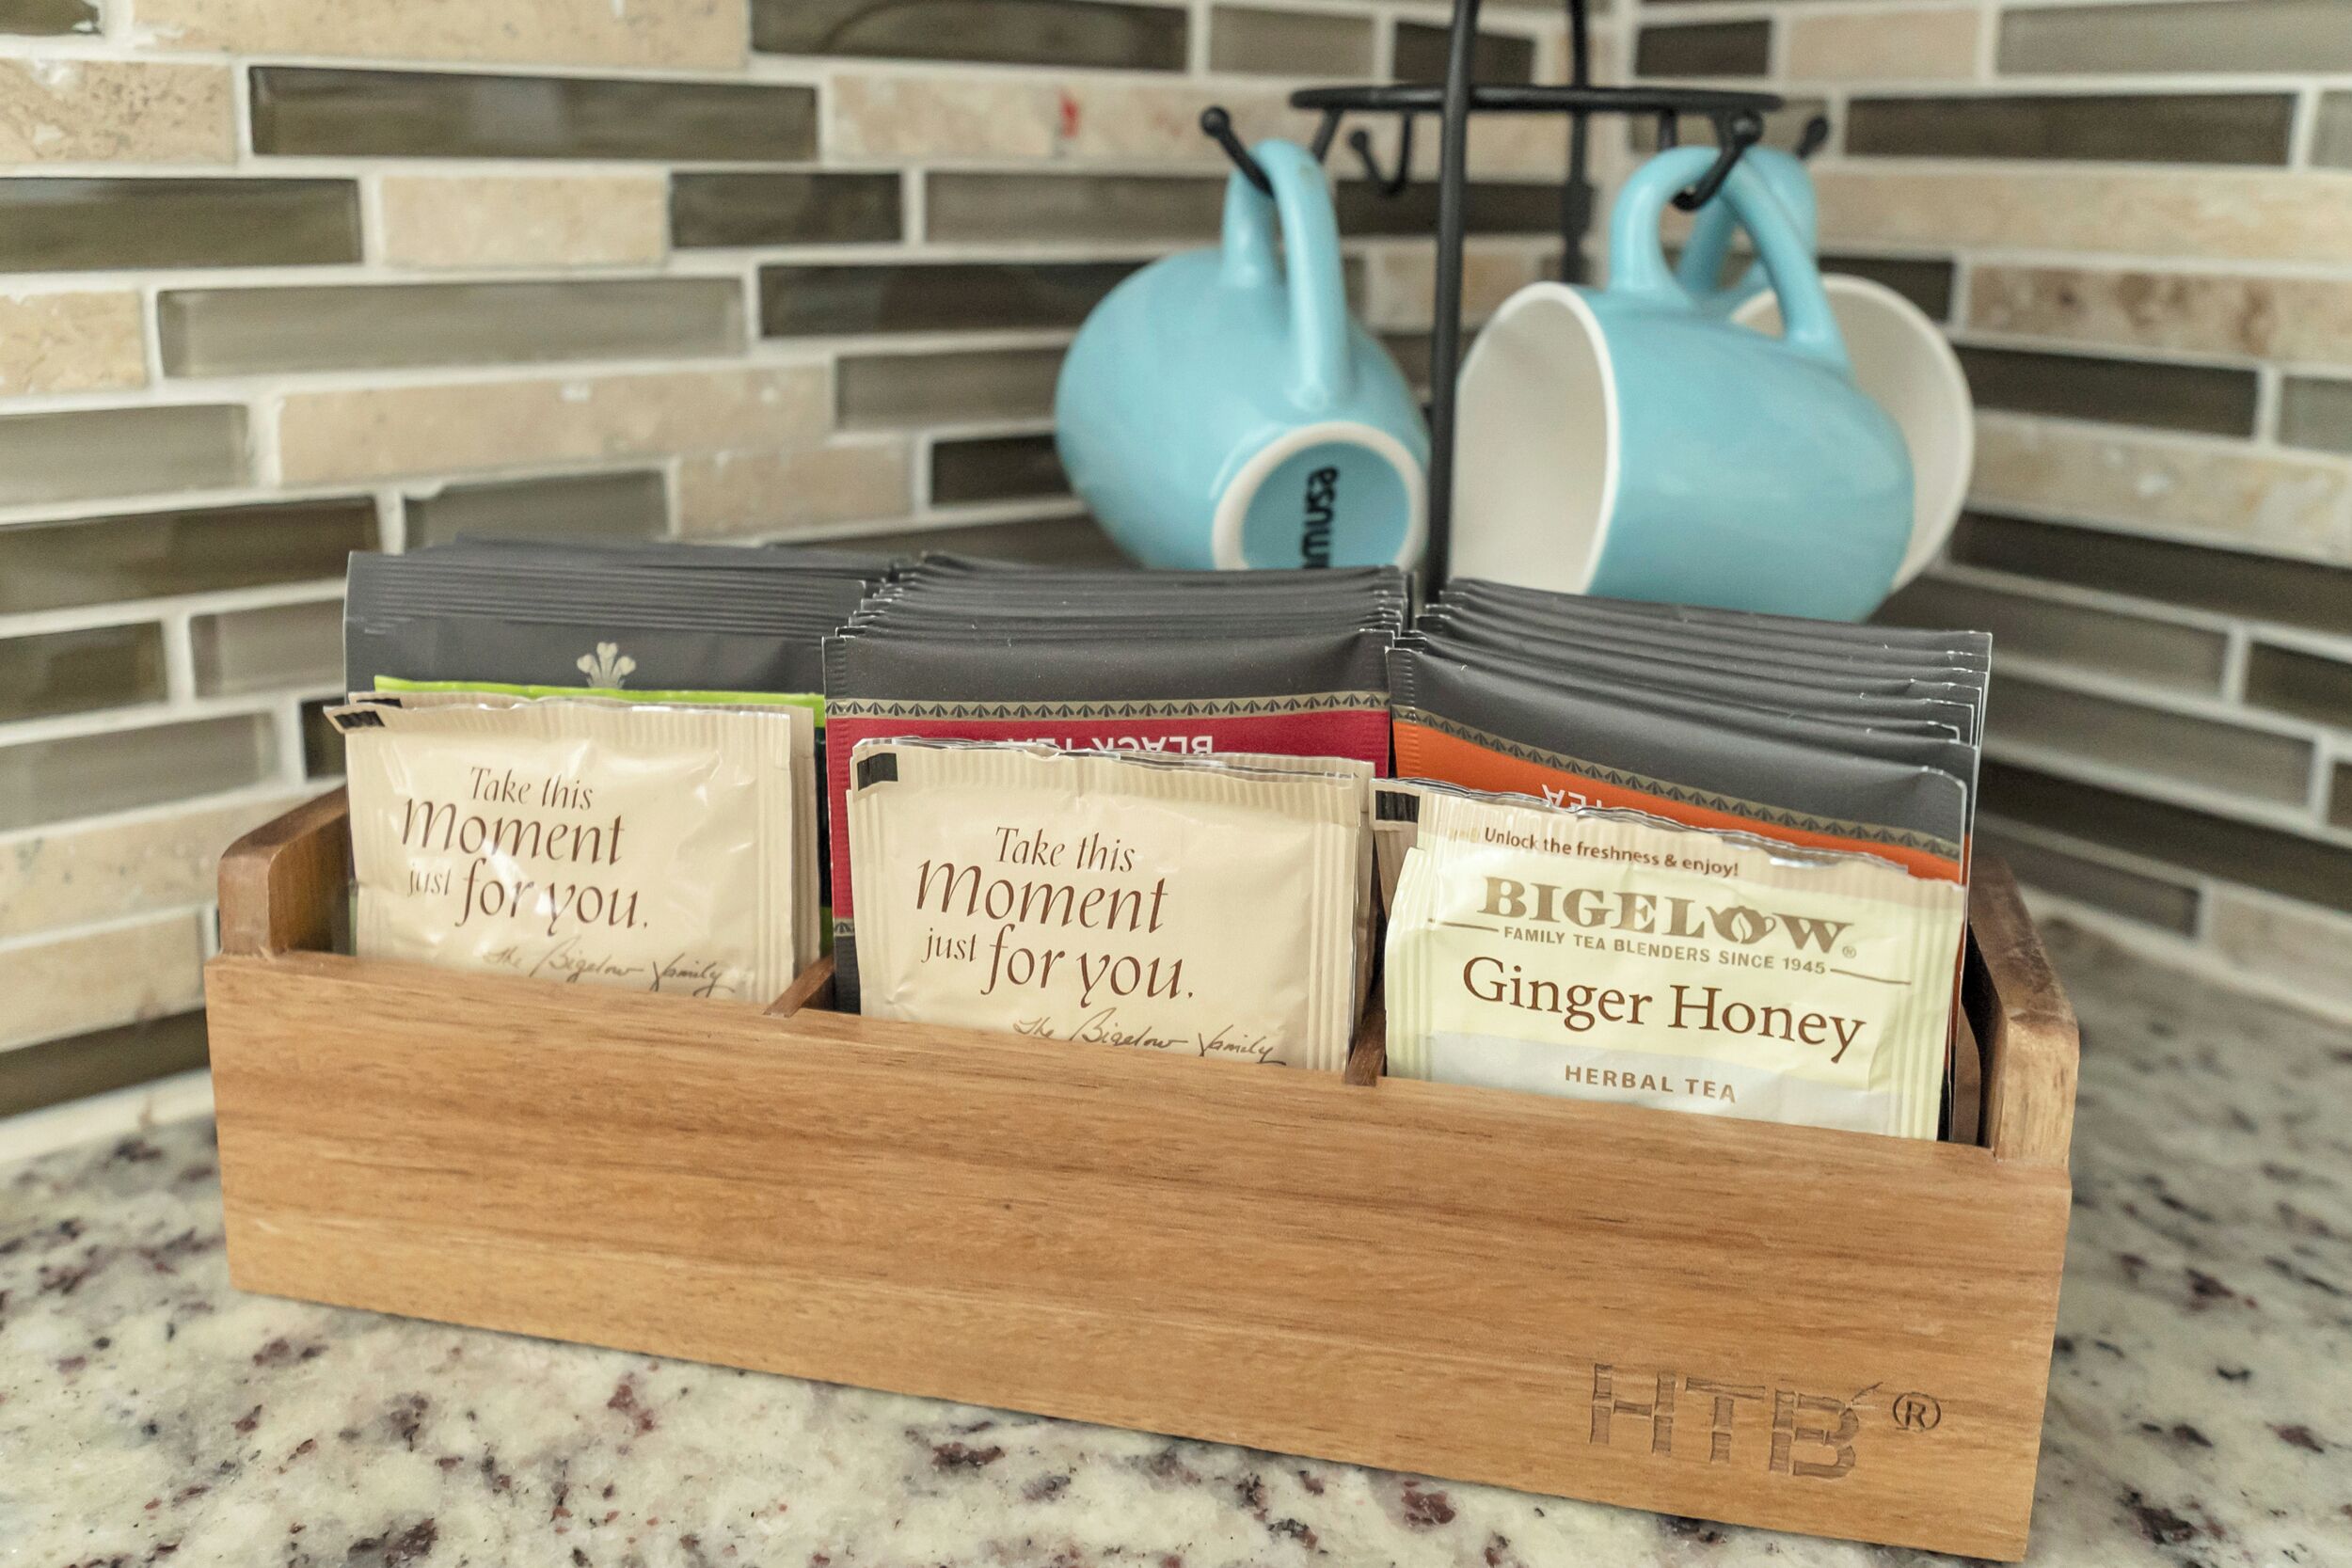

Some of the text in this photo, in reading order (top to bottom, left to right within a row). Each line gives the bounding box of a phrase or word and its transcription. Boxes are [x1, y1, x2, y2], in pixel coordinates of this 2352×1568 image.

[1091, 735, 1213, 754] BLACK
[471, 767, 595, 811] Take this
[401, 798, 626, 865] Moment
[995, 827, 1136, 874] Take this
[1485, 827, 1739, 878] Unlock the freshness & enjoy!
[407, 857, 650, 937] just for you.
[915, 860, 1169, 934] Moment
[920, 924, 1196, 1008] just for you.
[1504, 926, 1826, 975] FAMILY TEA BLENDERS SINCE 1945
[1462, 956, 1867, 1064] Ginger Honey
[1565, 1064, 1737, 1105] HERBAL TEA
